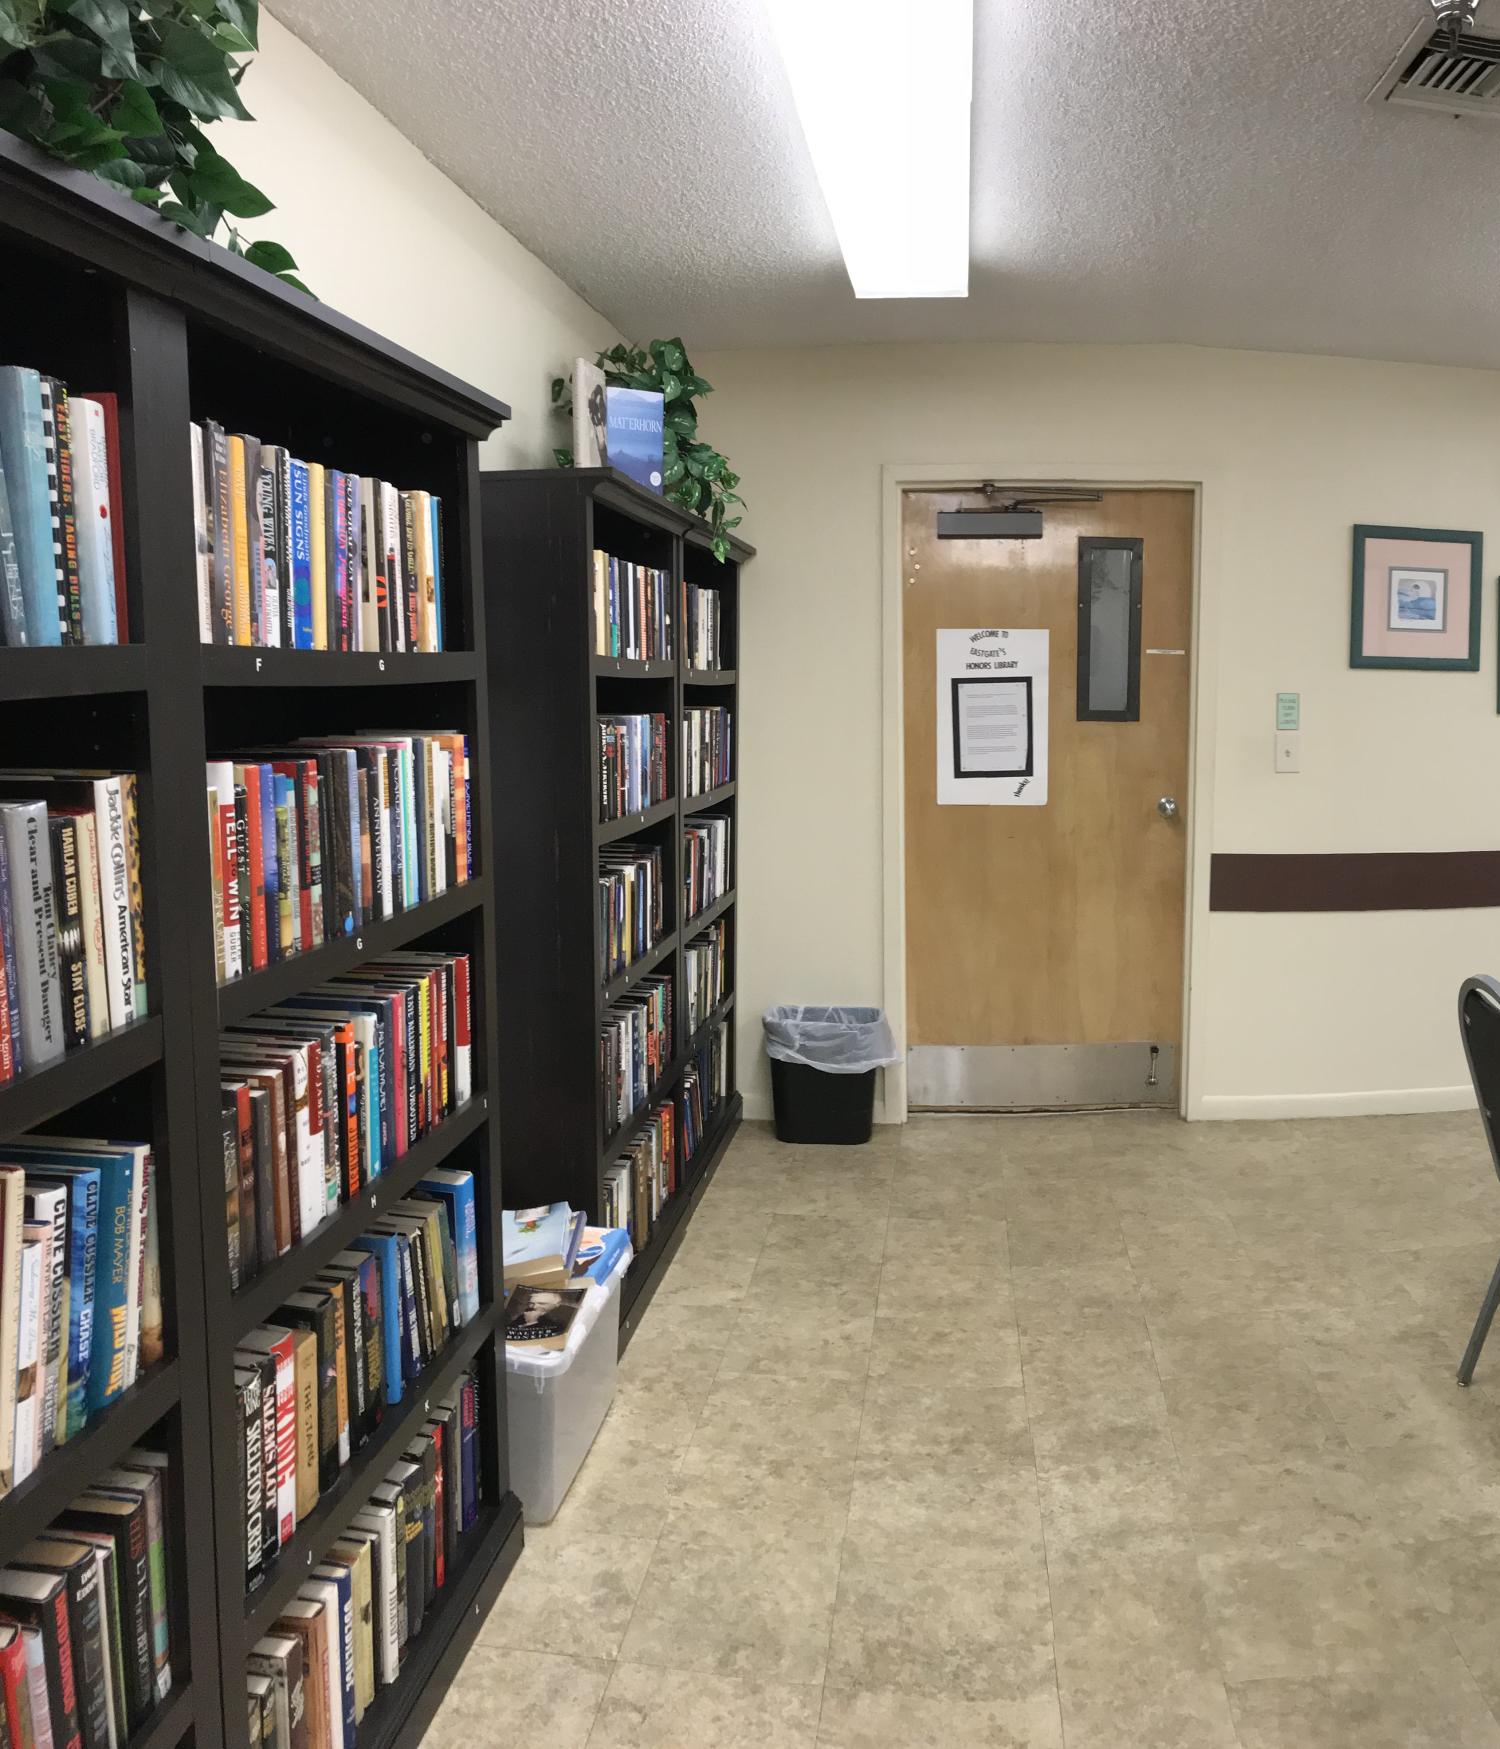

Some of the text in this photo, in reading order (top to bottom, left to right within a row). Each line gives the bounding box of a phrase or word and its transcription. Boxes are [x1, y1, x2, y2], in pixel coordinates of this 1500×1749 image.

[608, 415, 662, 433] MATTERHORN
[261, 473, 276, 552] YOUNG WIVES
[294, 470, 306, 560] SUN SIGNS
[221, 565, 233, 630] George
[255, 657, 262, 672] F
[379, 659, 385, 671] G
[965, 660, 1018, 671] HONORS LIBRARY
[969, 630, 1009, 643] WELCOME TO
[62, 827, 76, 876] HARLAN
[225, 811, 237, 861] TELL
[236, 819, 245, 873] GUEST
[373, 797, 383, 896] ANNIVERSARY
[106, 785, 133, 1007] Jackie Collins American Star
[228, 879, 241, 920] WIN
[27, 817, 53, 1044] Clear and Present Danger
[42, 881, 57, 981] Tom Clancy
[356, 937, 363, 950] G
[70, 961, 87, 1033] STAY CLOSE
[2, 1033, 11, 1071] Again
[83, 1179, 99, 1304] CLIVE CUSSLER
[112, 1205, 126, 1284] BOB MAYER
[51, 1198, 66, 1352] CLIVE CUSSLER
[79, 1308, 92, 1362] CHASE
[109, 1304, 127, 1349] WILD
[276, 1396, 297, 1489] KING
[304, 1383, 315, 1468] THE STAND
[246, 1420, 262, 1515] SKELETON
[266, 1466, 277, 1510] LOT
[247, 1511, 262, 1570] CREW
[306, 1550, 312, 1565] J
[343, 1599, 354, 1692] OBEDIENCE
